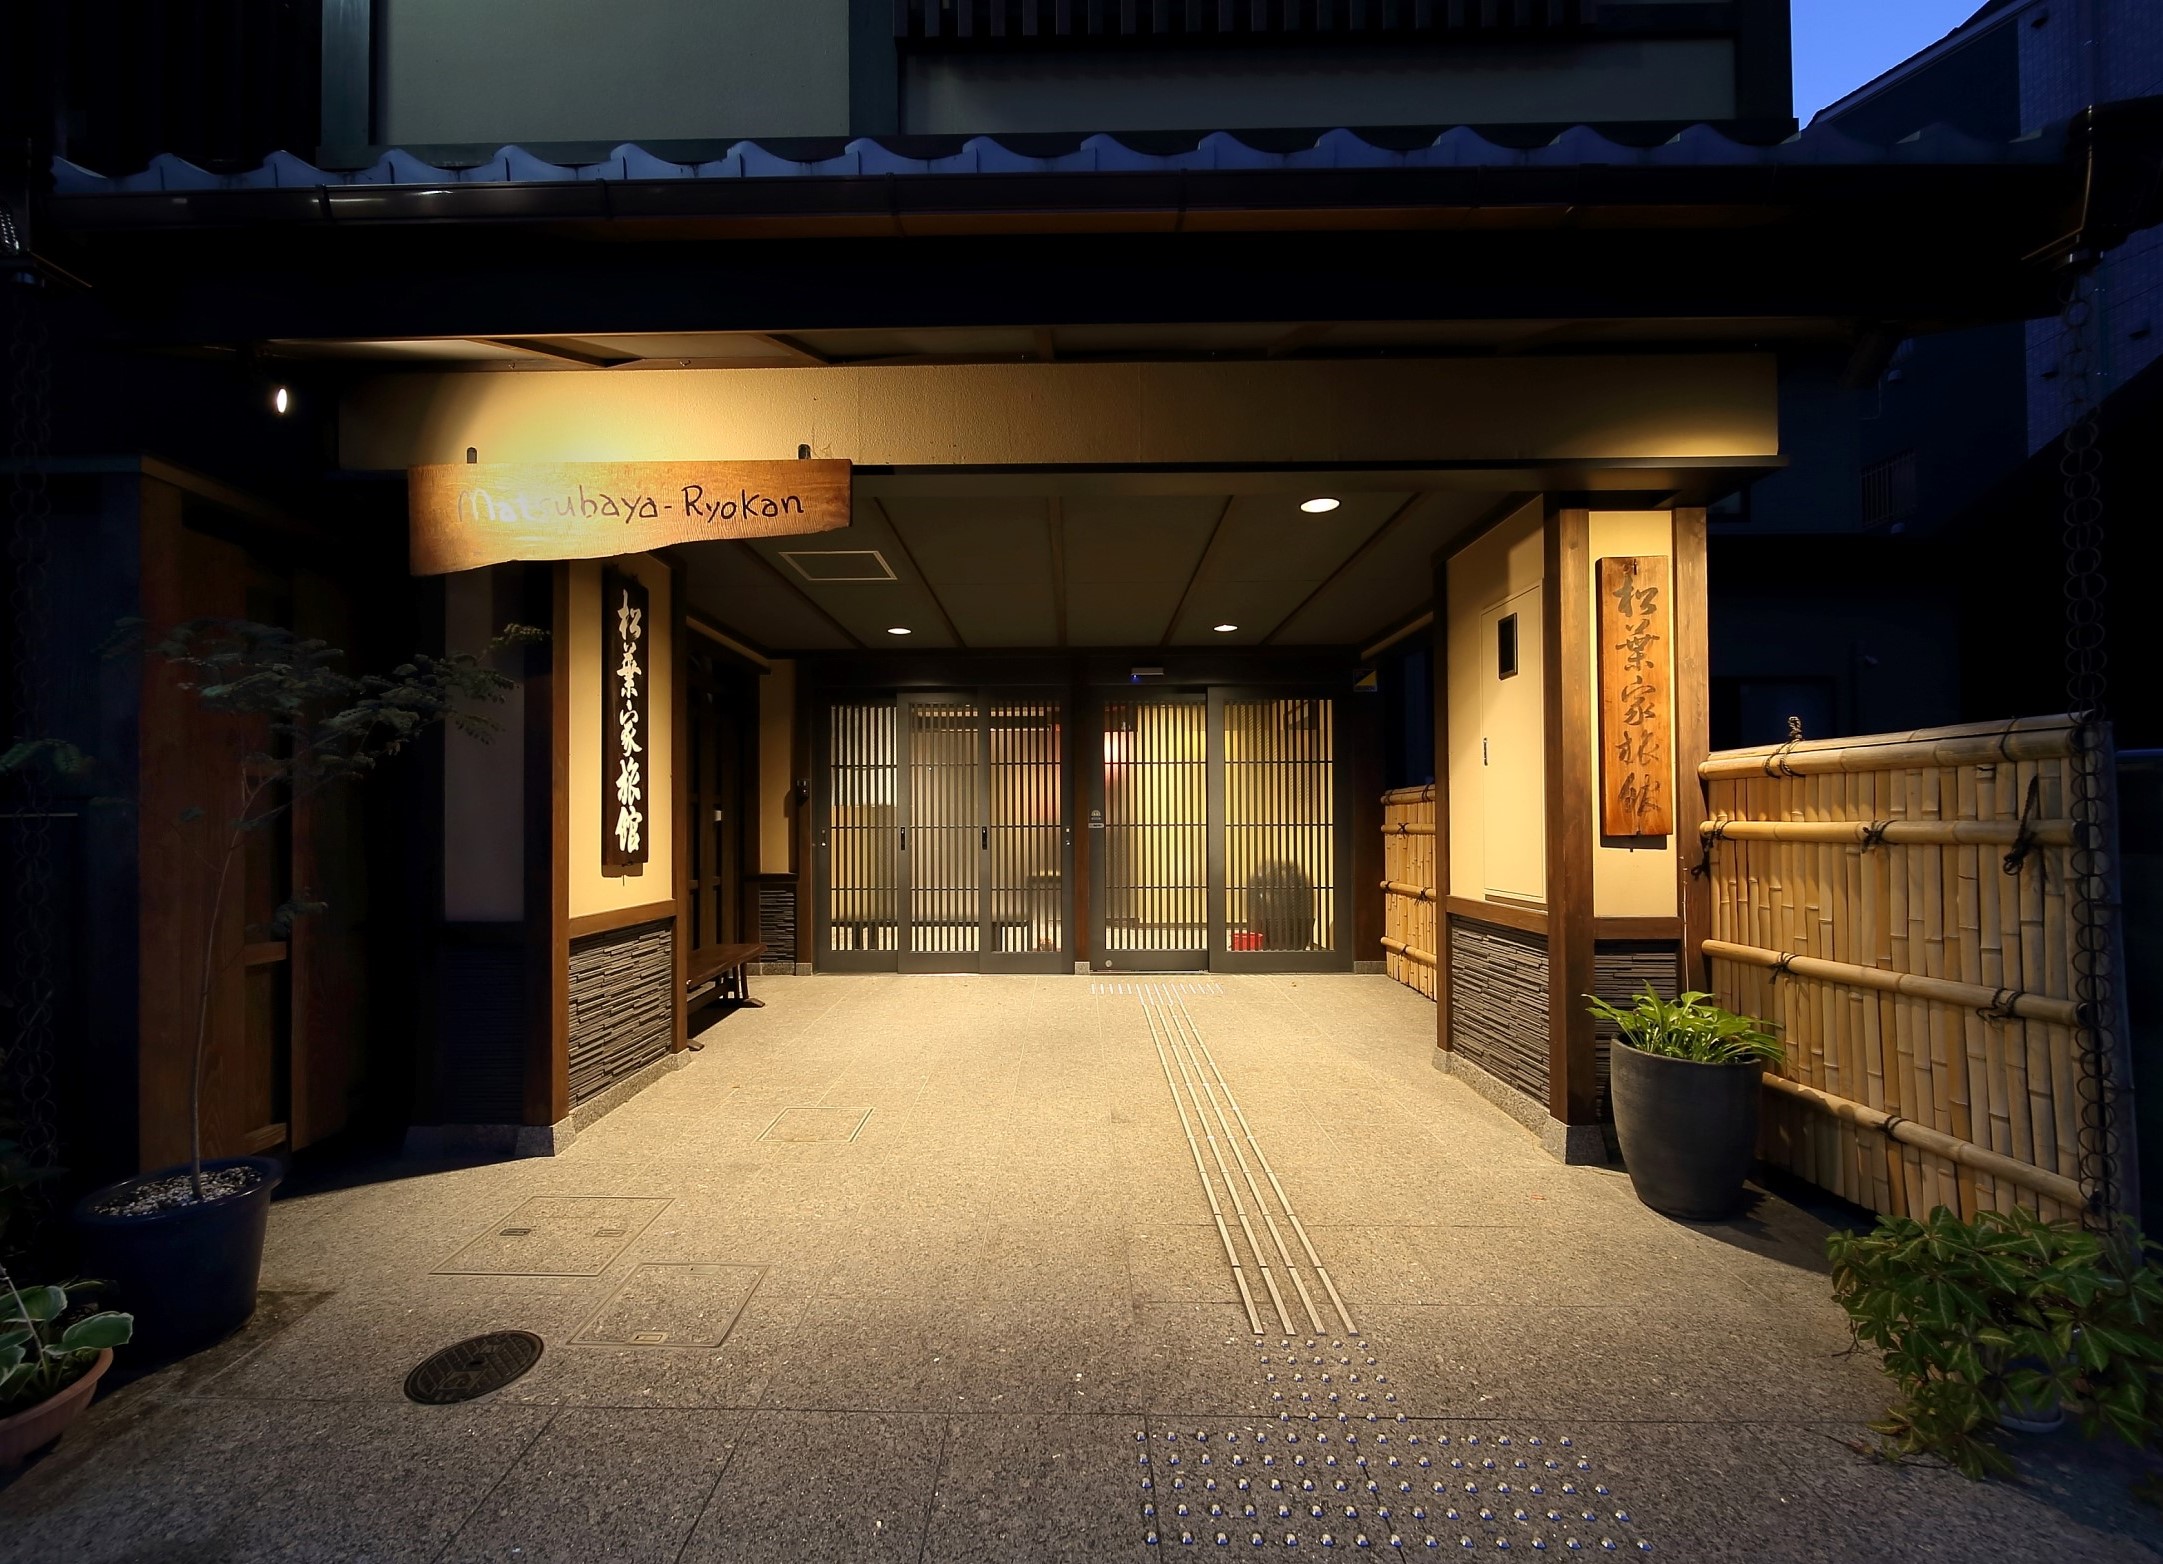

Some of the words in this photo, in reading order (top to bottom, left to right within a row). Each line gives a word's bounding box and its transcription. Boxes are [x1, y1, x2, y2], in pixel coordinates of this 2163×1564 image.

[616, 589, 642, 853] 松葉家旅館
